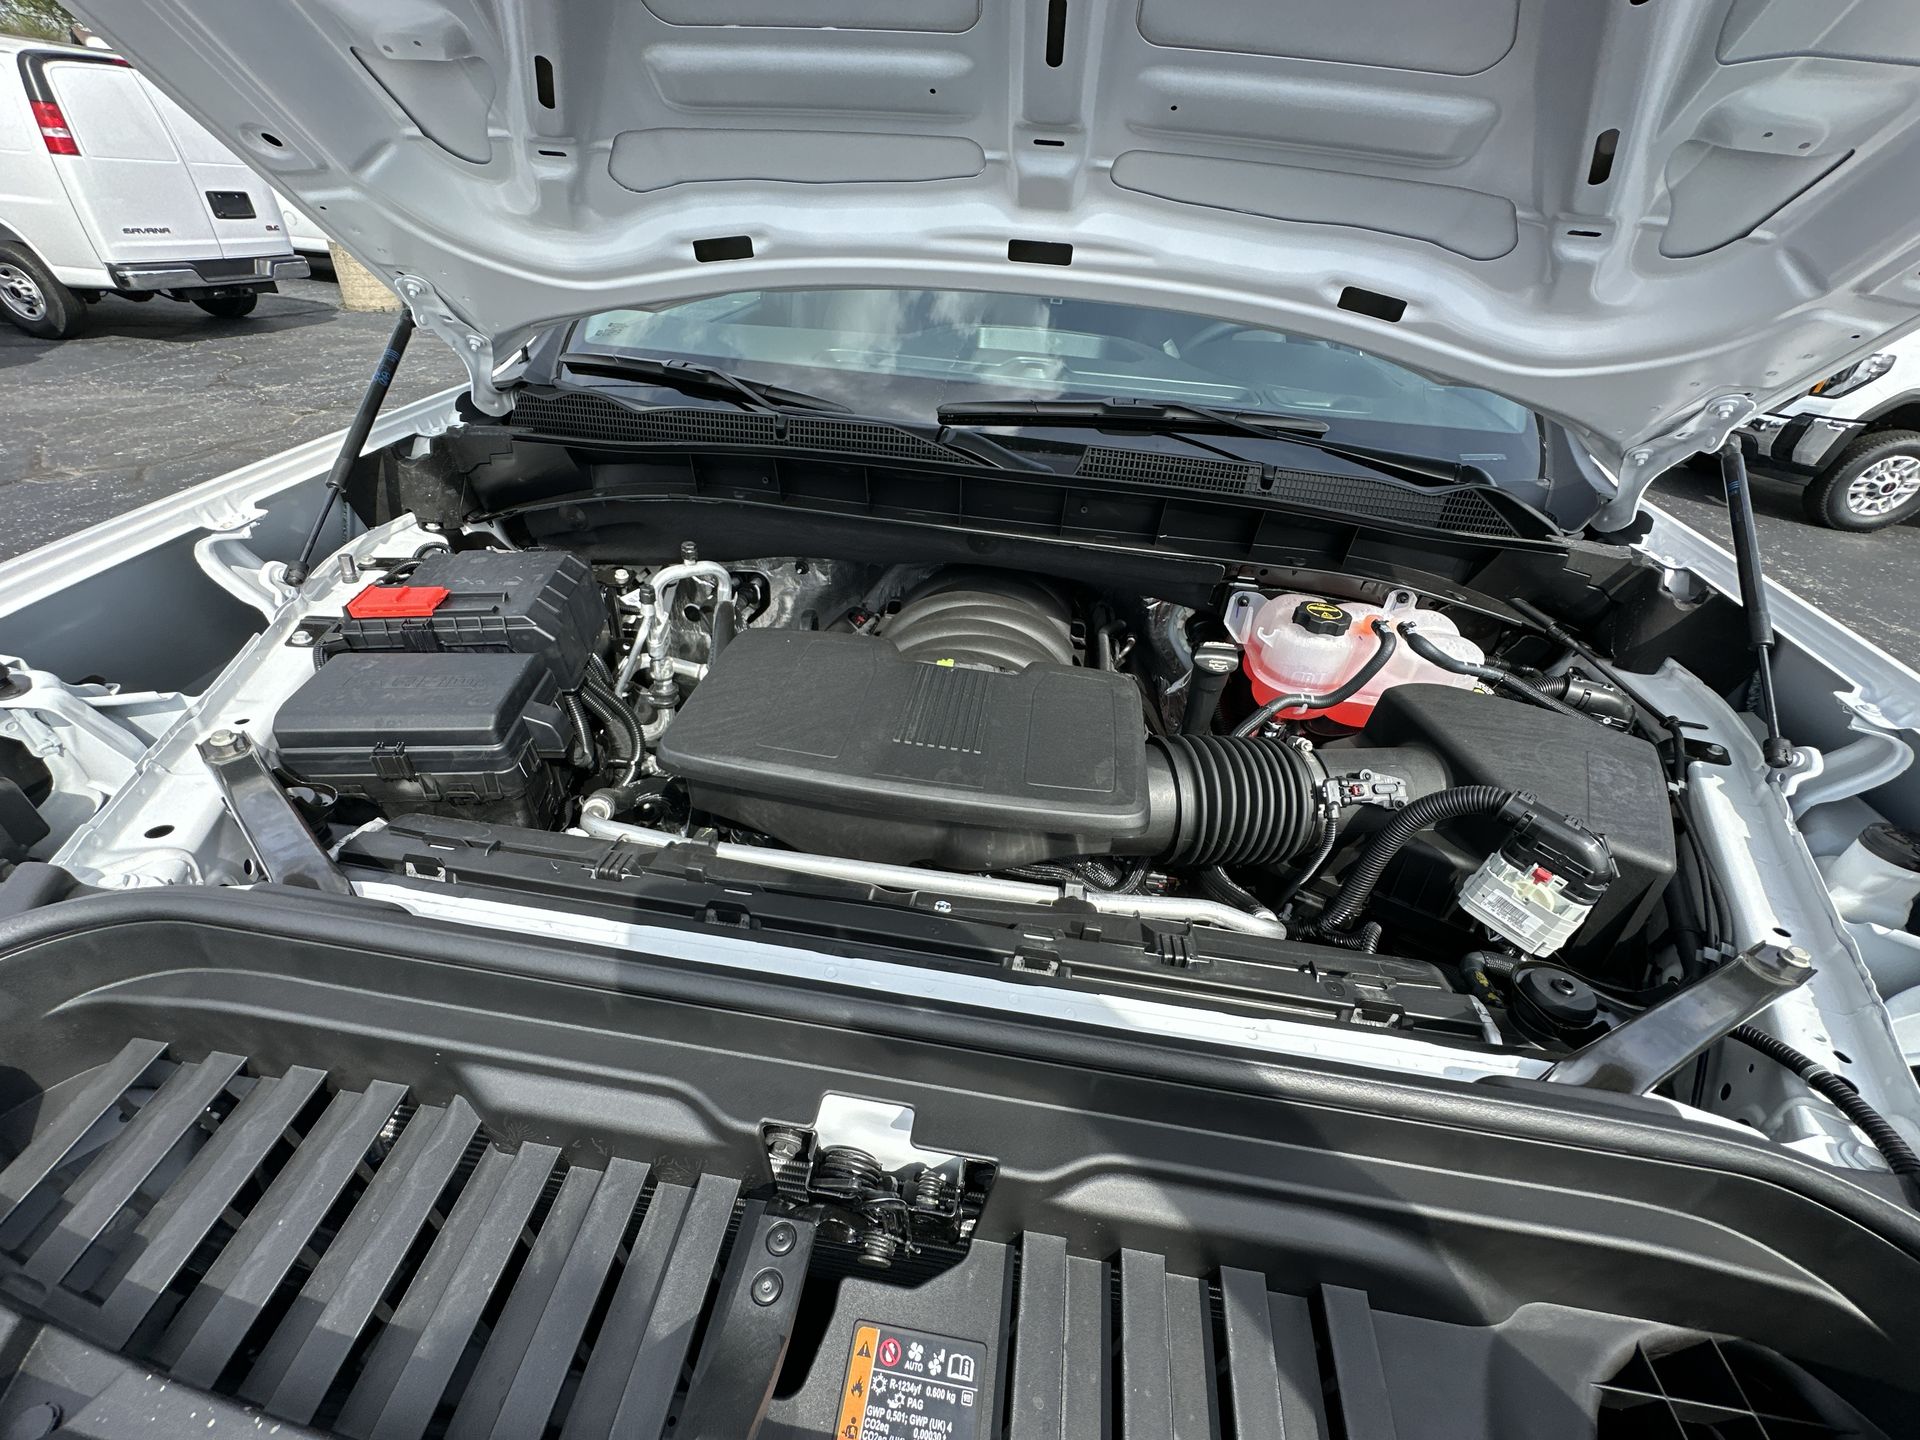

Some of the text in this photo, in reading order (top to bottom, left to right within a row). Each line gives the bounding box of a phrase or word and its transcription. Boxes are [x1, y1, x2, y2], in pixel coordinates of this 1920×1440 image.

[904, 1360, 923, 1372] AUTO
[889, 1379, 956, 1404] R-1234yf 0.600 kg
[907, 1397, 924, 1410] PAG
[864, 1417, 890, 1435] CO2eq
[866, 1405, 885, 1418] GWP
[909, 1414, 928, 1427] GWP
[929, 1418, 946, 1433] (UK)
[947, 1421, 952, 1433] 4
